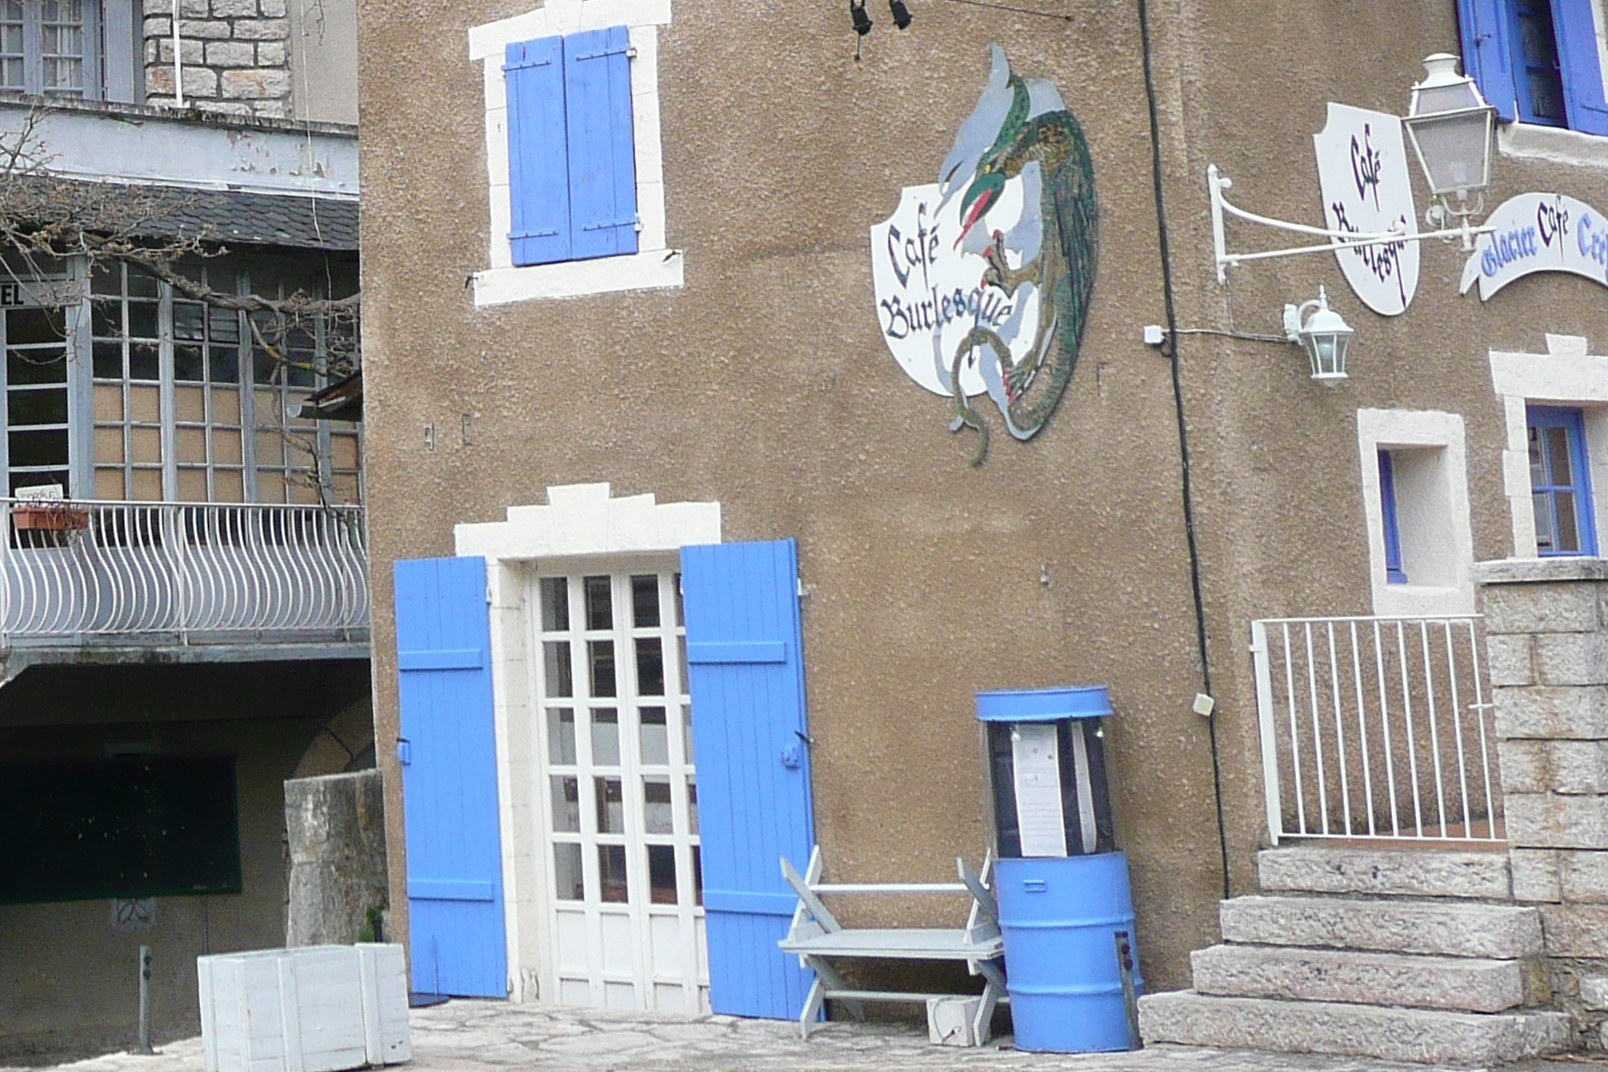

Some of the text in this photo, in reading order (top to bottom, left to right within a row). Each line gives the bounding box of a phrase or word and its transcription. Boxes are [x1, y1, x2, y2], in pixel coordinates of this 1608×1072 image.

[1350, 123, 1382, 213] Café
[887, 201, 940, 291] Café
[1480, 221, 1538, 278] Glacier
[880, 286, 1013, 369] Burlesque
